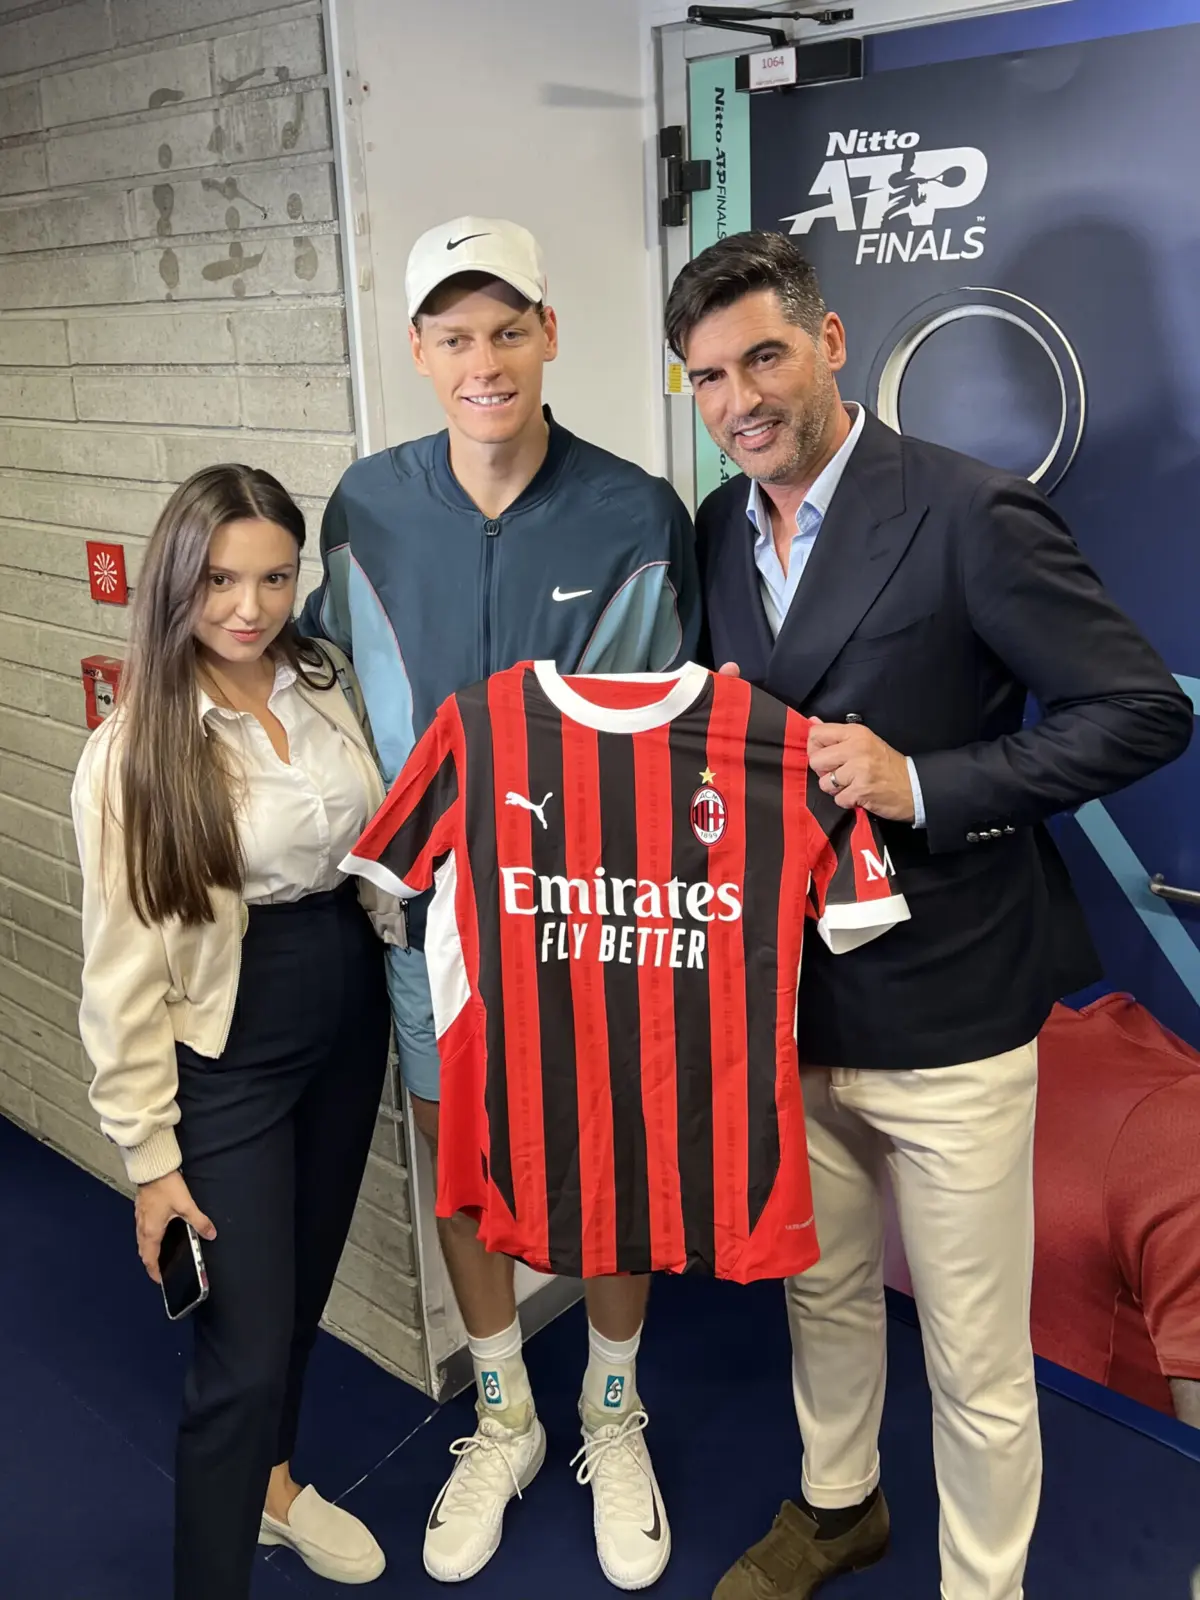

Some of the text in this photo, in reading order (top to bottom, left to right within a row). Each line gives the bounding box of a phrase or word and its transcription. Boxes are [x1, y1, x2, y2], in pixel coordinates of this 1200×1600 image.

[762, 56, 784, 69] 1064
[714, 87, 725, 143] Nitto
[825, 129, 920, 157] Nitto
[778, 147, 988, 235] ATP
[855, 226, 987, 265] FINALS
[699, 790, 719, 801] ACM
[700, 831, 718, 839] 1899
[500, 866, 742, 922] Emirates
[541, 922, 706, 970] FLY BETTER
